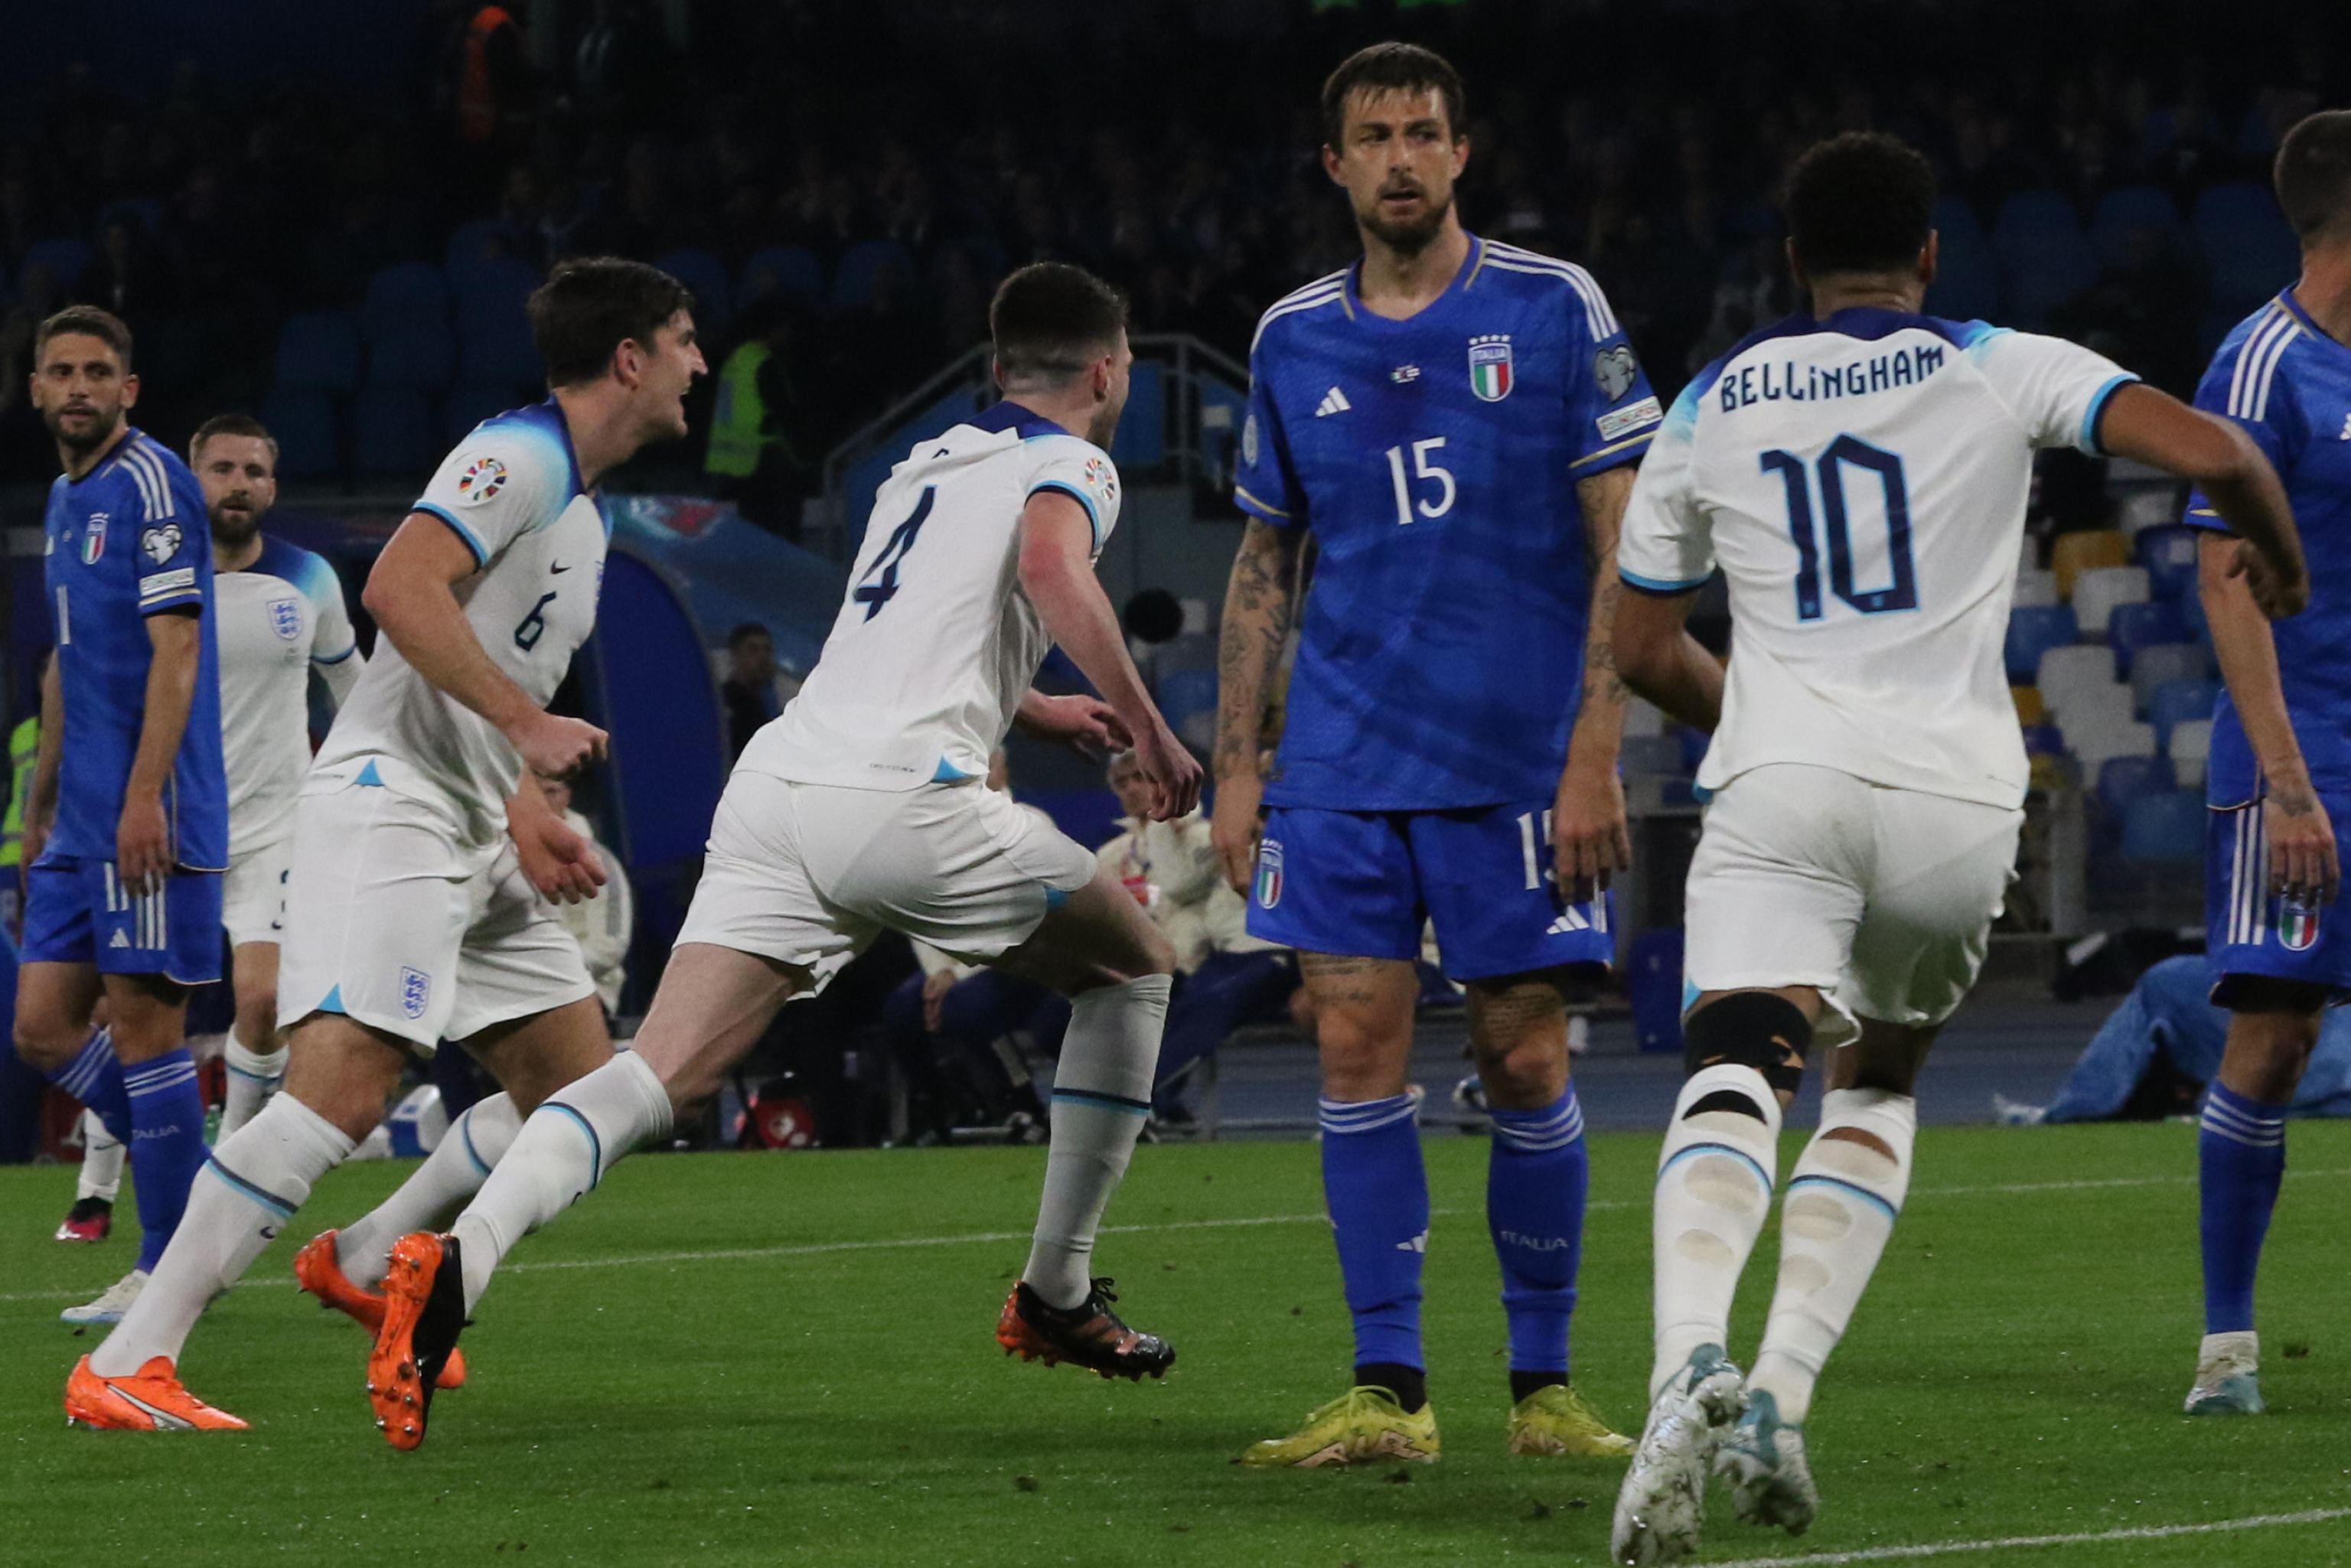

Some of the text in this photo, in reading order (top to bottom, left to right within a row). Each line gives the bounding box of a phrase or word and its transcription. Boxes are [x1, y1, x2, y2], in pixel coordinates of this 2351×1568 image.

[1386, 436, 1456, 525] 15
[853, 484, 937, 624] 4
[1759, 432, 1920, 624] 10
[514, 591, 556, 651] 6
[1500, 1230, 1569, 1252] ITALIA
